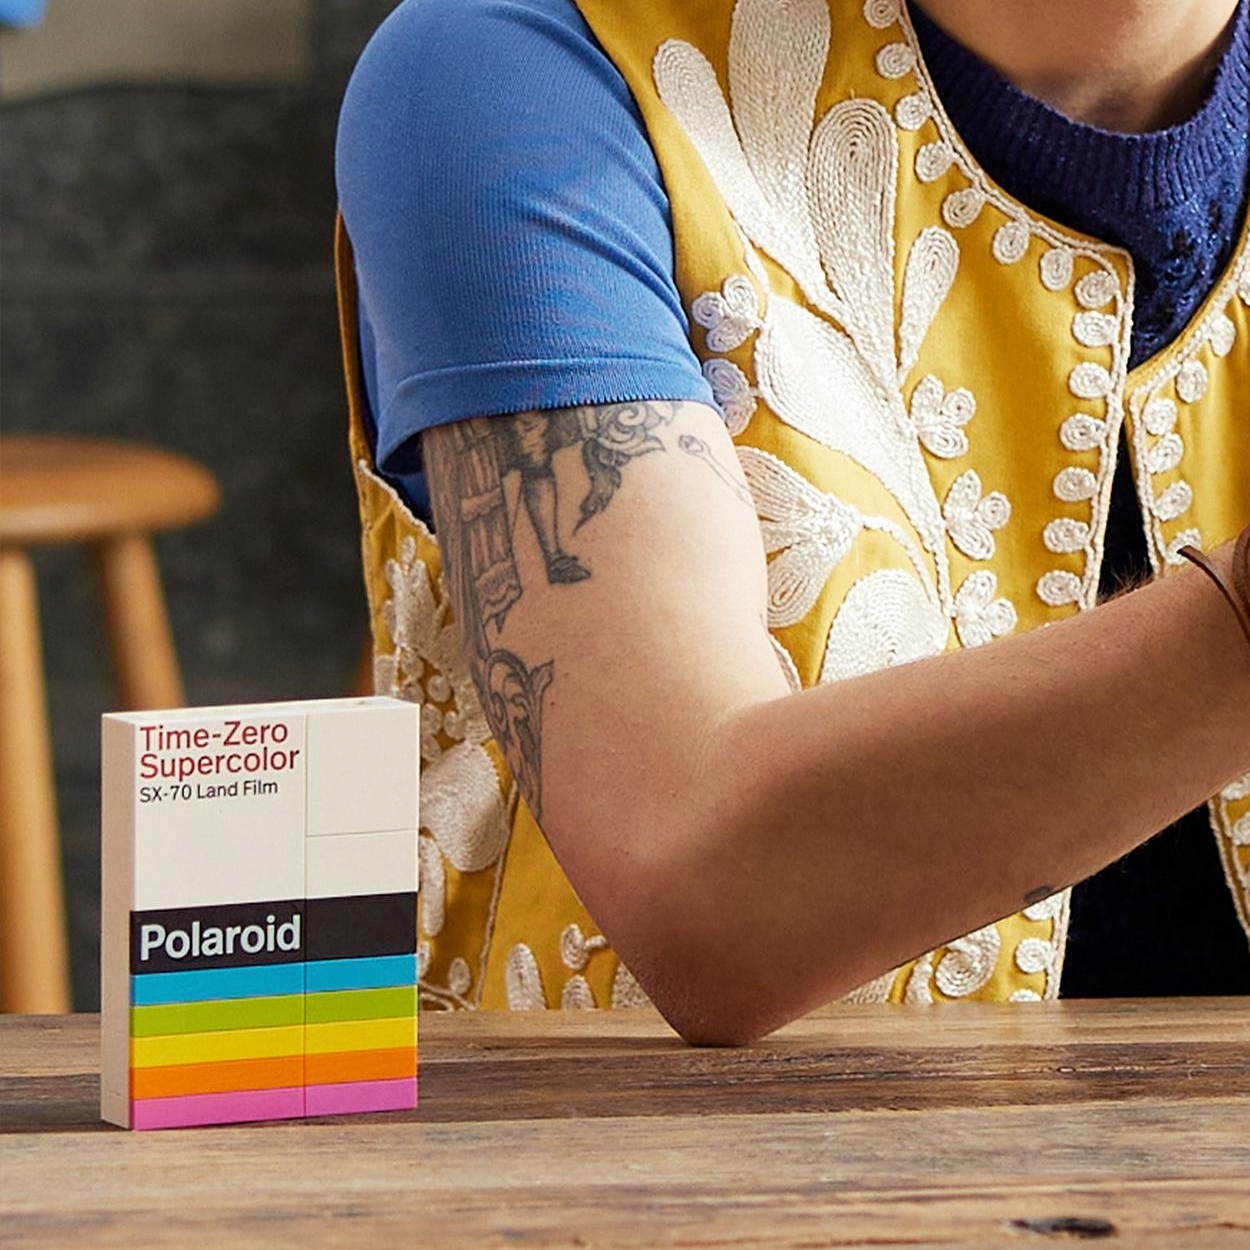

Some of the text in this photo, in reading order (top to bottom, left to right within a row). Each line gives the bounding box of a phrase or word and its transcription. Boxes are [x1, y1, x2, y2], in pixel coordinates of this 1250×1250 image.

[140, 720, 288, 751] Time-Zero
[140, 747, 300, 782] Supercolor
[140, 780, 278, 803] SX-70 Land Film
[140, 914, 301, 961] Polaroid
